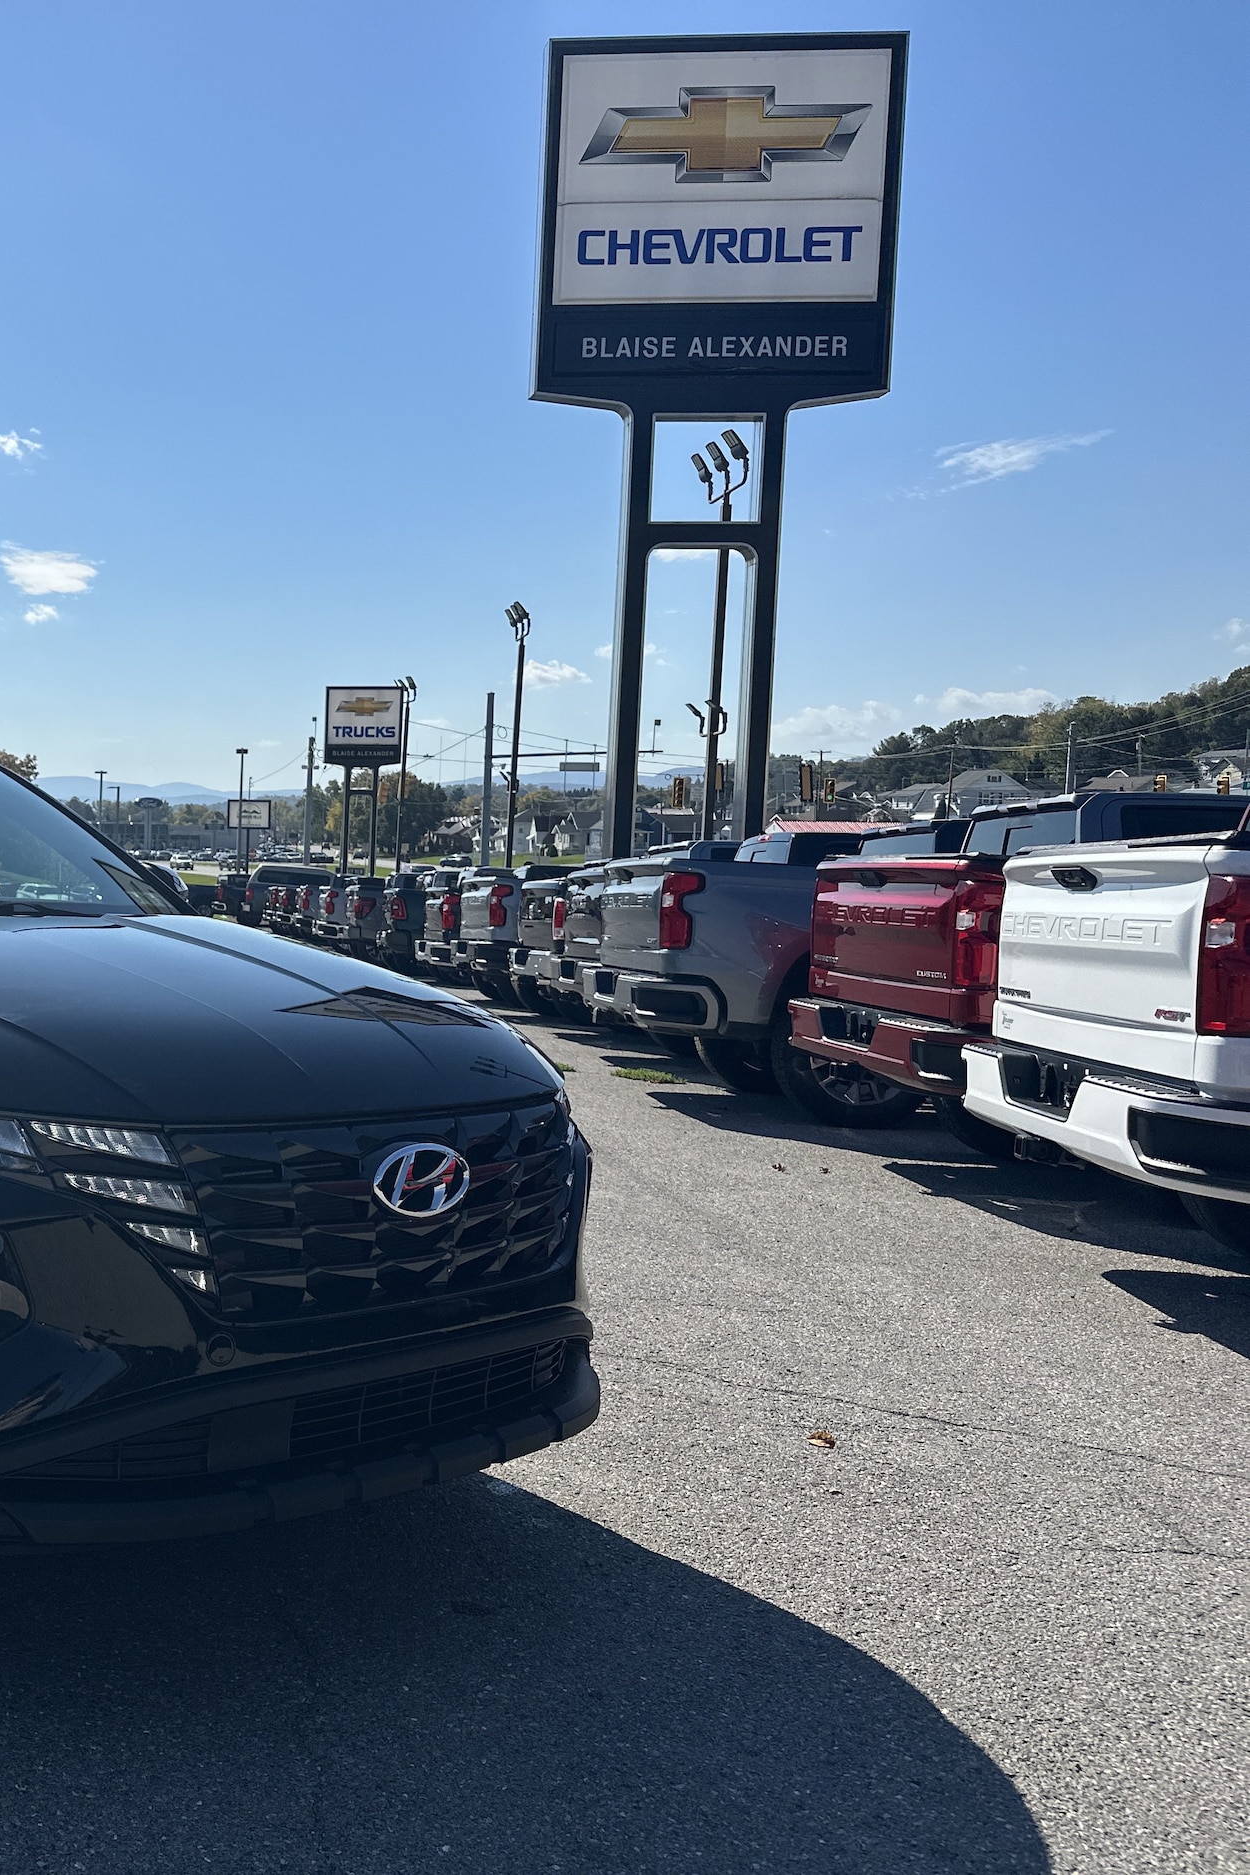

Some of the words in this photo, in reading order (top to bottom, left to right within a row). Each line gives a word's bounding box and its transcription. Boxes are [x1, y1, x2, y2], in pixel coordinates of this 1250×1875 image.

[578, 226, 863, 265] CHEVROLET
[581, 337, 676, 359] BLAISE
[687, 335, 848, 358] ALEXANDER
[332, 725, 396, 738] TRUCKS
[1001, 911, 1174, 946] CHEVROLET
[916, 970, 947, 980] CUSTOM
[1154, 1006, 1191, 1023] RST
